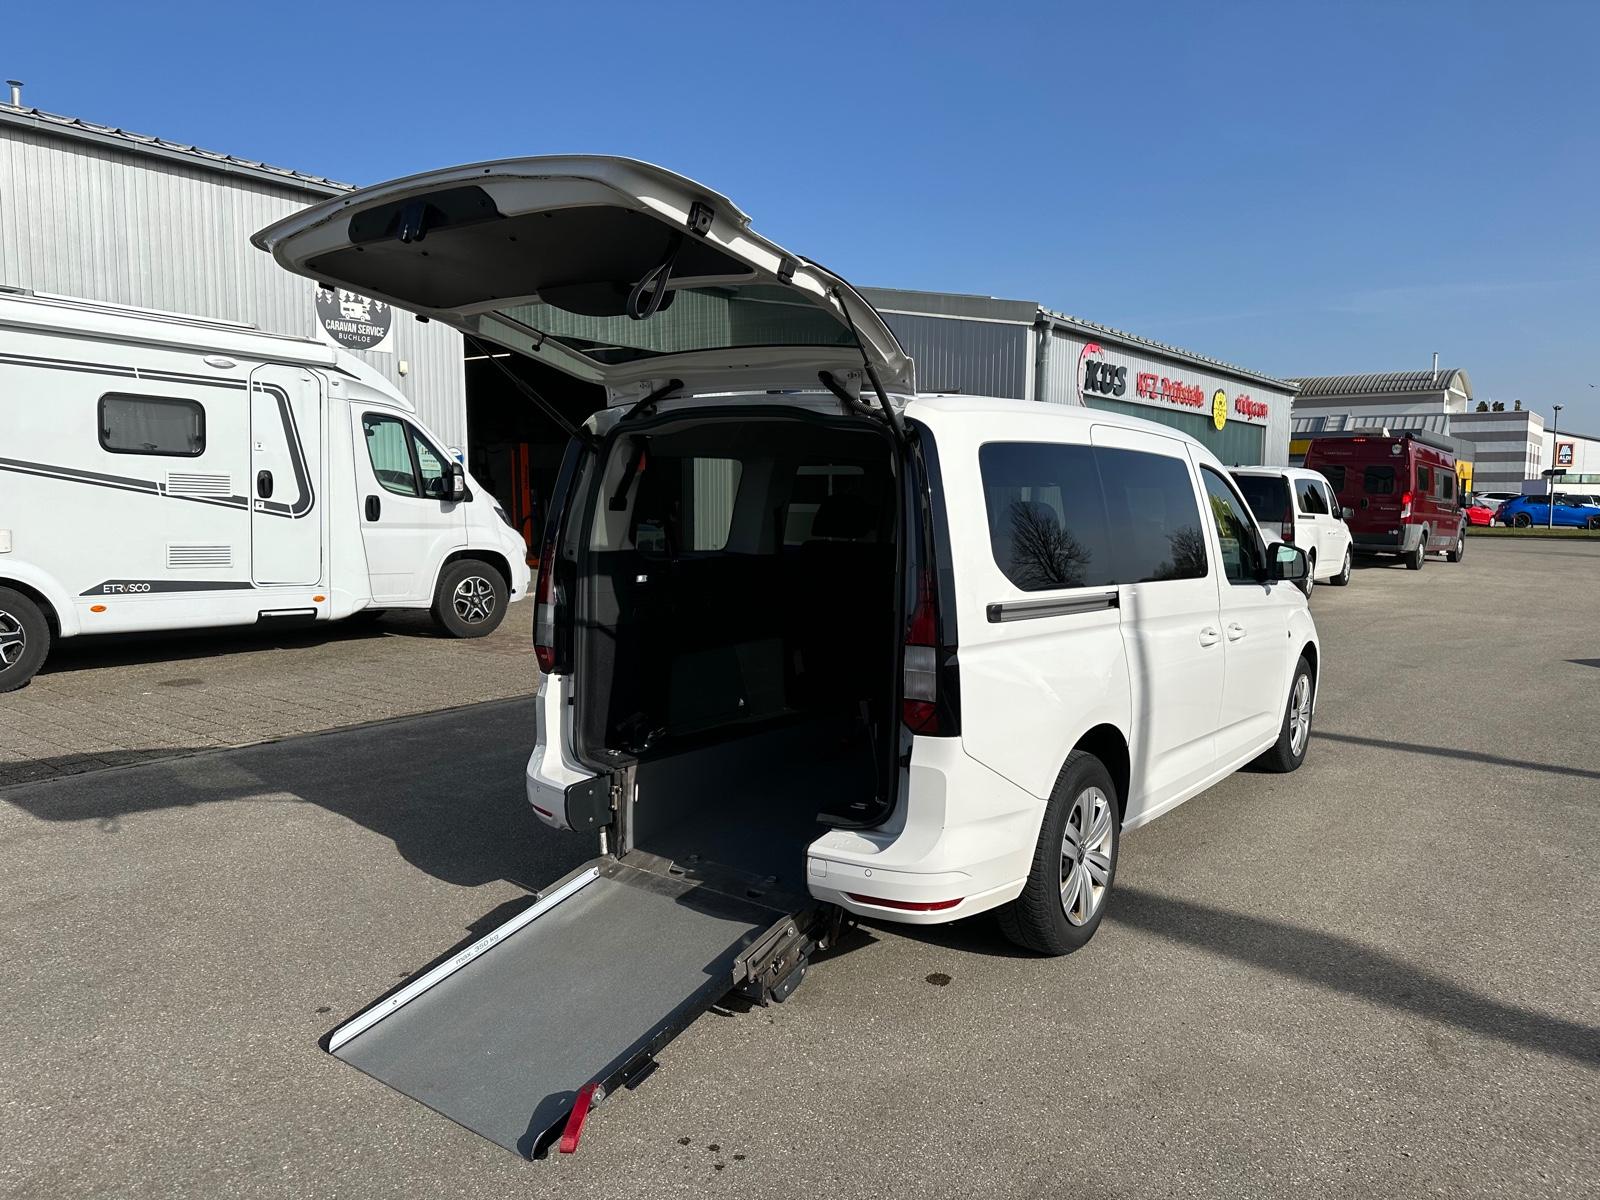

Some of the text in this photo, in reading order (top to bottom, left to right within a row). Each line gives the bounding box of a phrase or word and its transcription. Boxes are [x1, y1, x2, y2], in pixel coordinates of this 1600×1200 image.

[326, 320, 385, 337] CARAVAN SERVICE
[338, 332, 371, 343] BUCHLOE
[475, 940, 489, 953] 350
